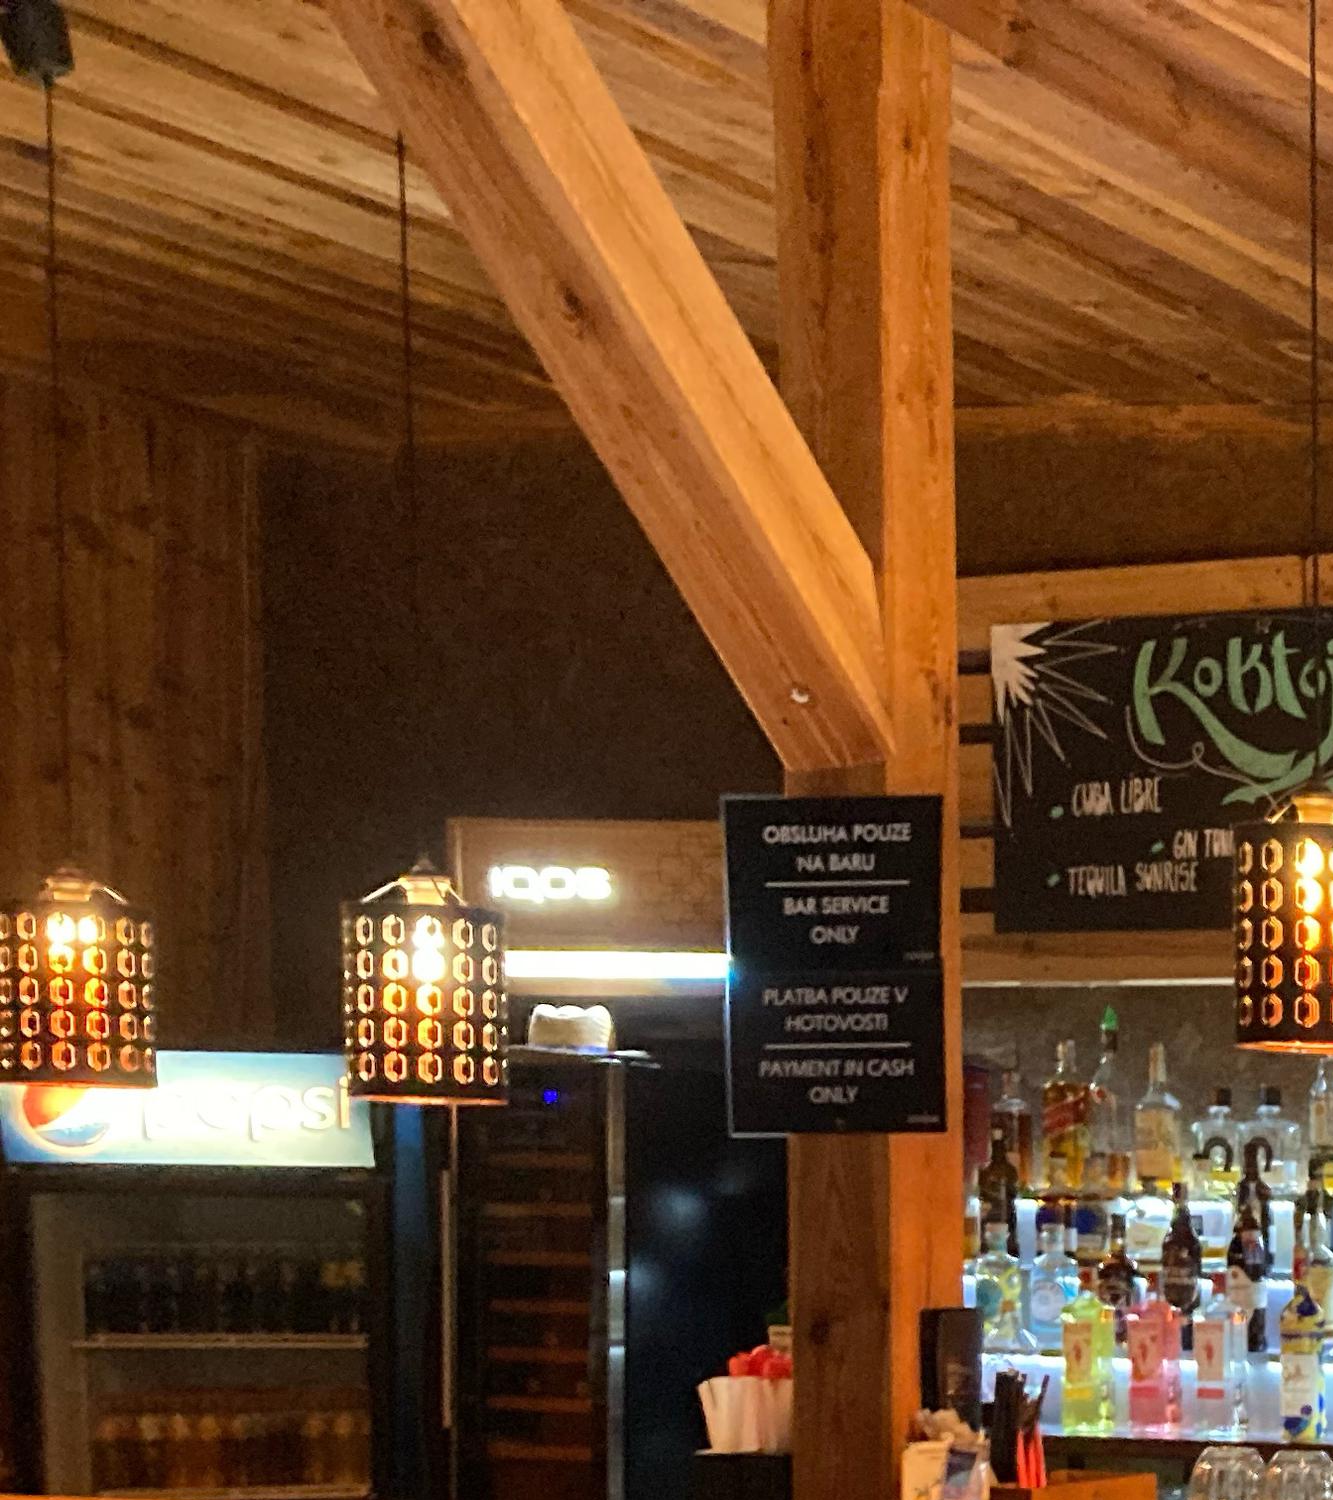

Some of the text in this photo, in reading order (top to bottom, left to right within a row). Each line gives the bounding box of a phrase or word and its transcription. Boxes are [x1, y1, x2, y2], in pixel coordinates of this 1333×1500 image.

[1073, 774, 1162, 818] CUBA LIBRE
[762, 823, 912, 844] OBSLUHA POUZE
[1172, 828, 1199, 860] GIN
[797, 852, 875, 873] NA BARU
[1067, 860, 1199, 899] TEQUILA SUNRISE
[783, 895, 890, 916] BAR SERVICE
[809, 924, 860, 944] ONLY
[763, 985, 909, 1006] PLATBA POUZE V
[785, 1012, 889, 1032] HOTOVOSTI
[759, 1057, 914, 1078] PAYMENT IN CASH
[808, 1085, 859, 1104] ONLY
